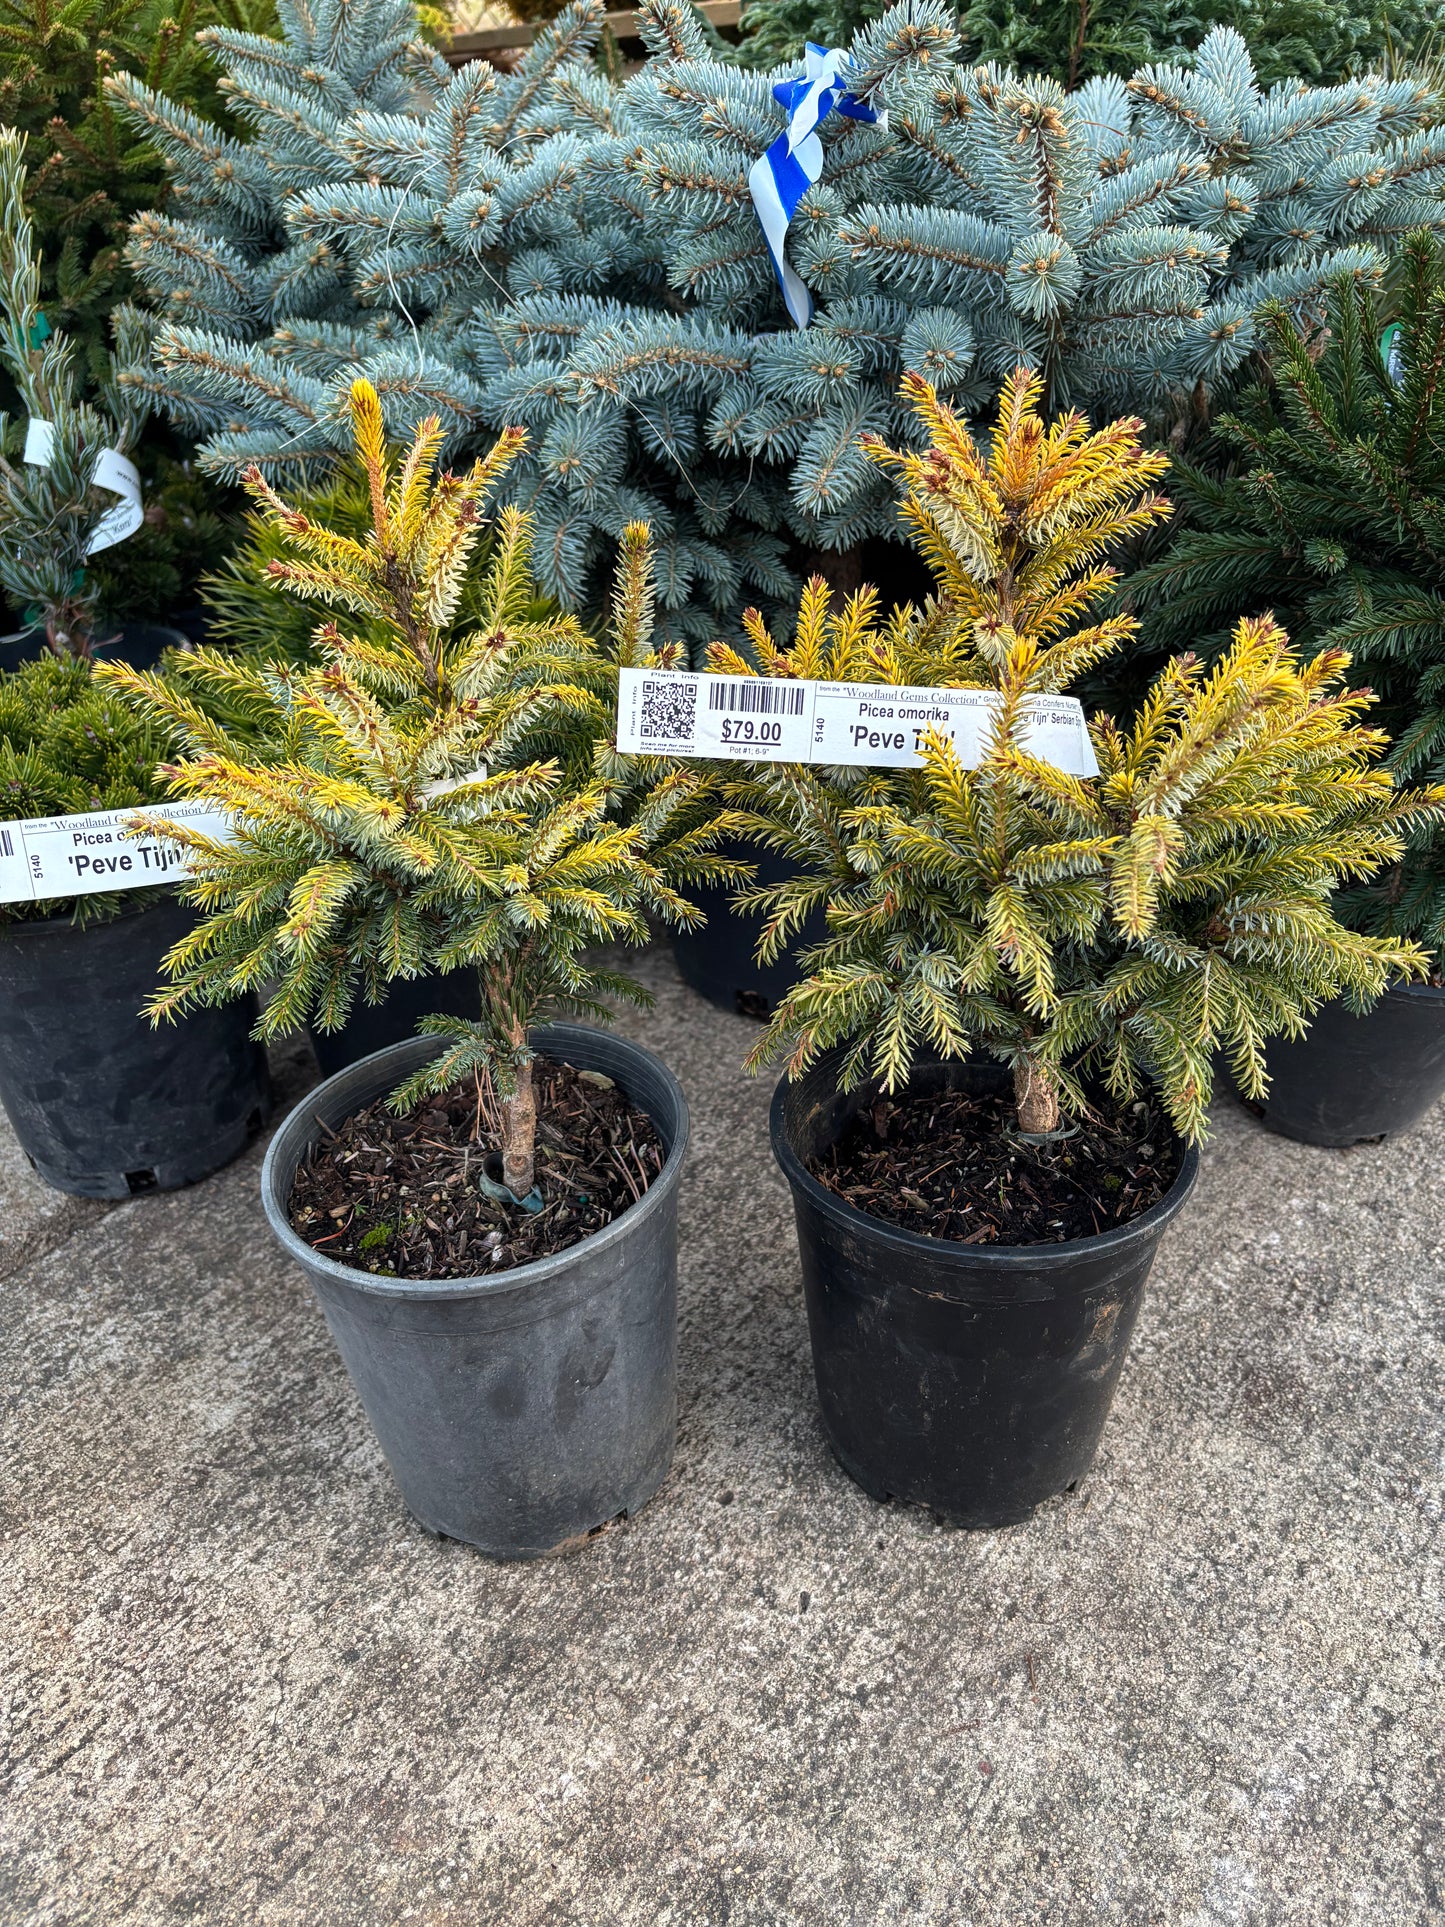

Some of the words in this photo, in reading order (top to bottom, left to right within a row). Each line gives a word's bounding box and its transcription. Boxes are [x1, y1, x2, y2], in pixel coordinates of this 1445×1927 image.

[843, 687, 898, 700] "Woodland
[901, 690, 928, 702] Gems
[931, 692, 982, 705] Collection"
[1043, 698, 1065, 708] Conifers
[859, 702, 894, 718] Picea
[898, 706, 950, 721] omorika
[1051, 712, 1075, 726] Serbian
[721, 718, 782, 742] $79.00
[814, 717, 825, 743] 5140
[849, 725, 905, 750] 'Peve
[729, 746, 741, 754] Pot
[50, 815, 112, 830] "Woodland
[72, 831, 113, 847] Picea
[30, 854, 44, 879] 5140
[68, 854, 133, 877] 'Peve
